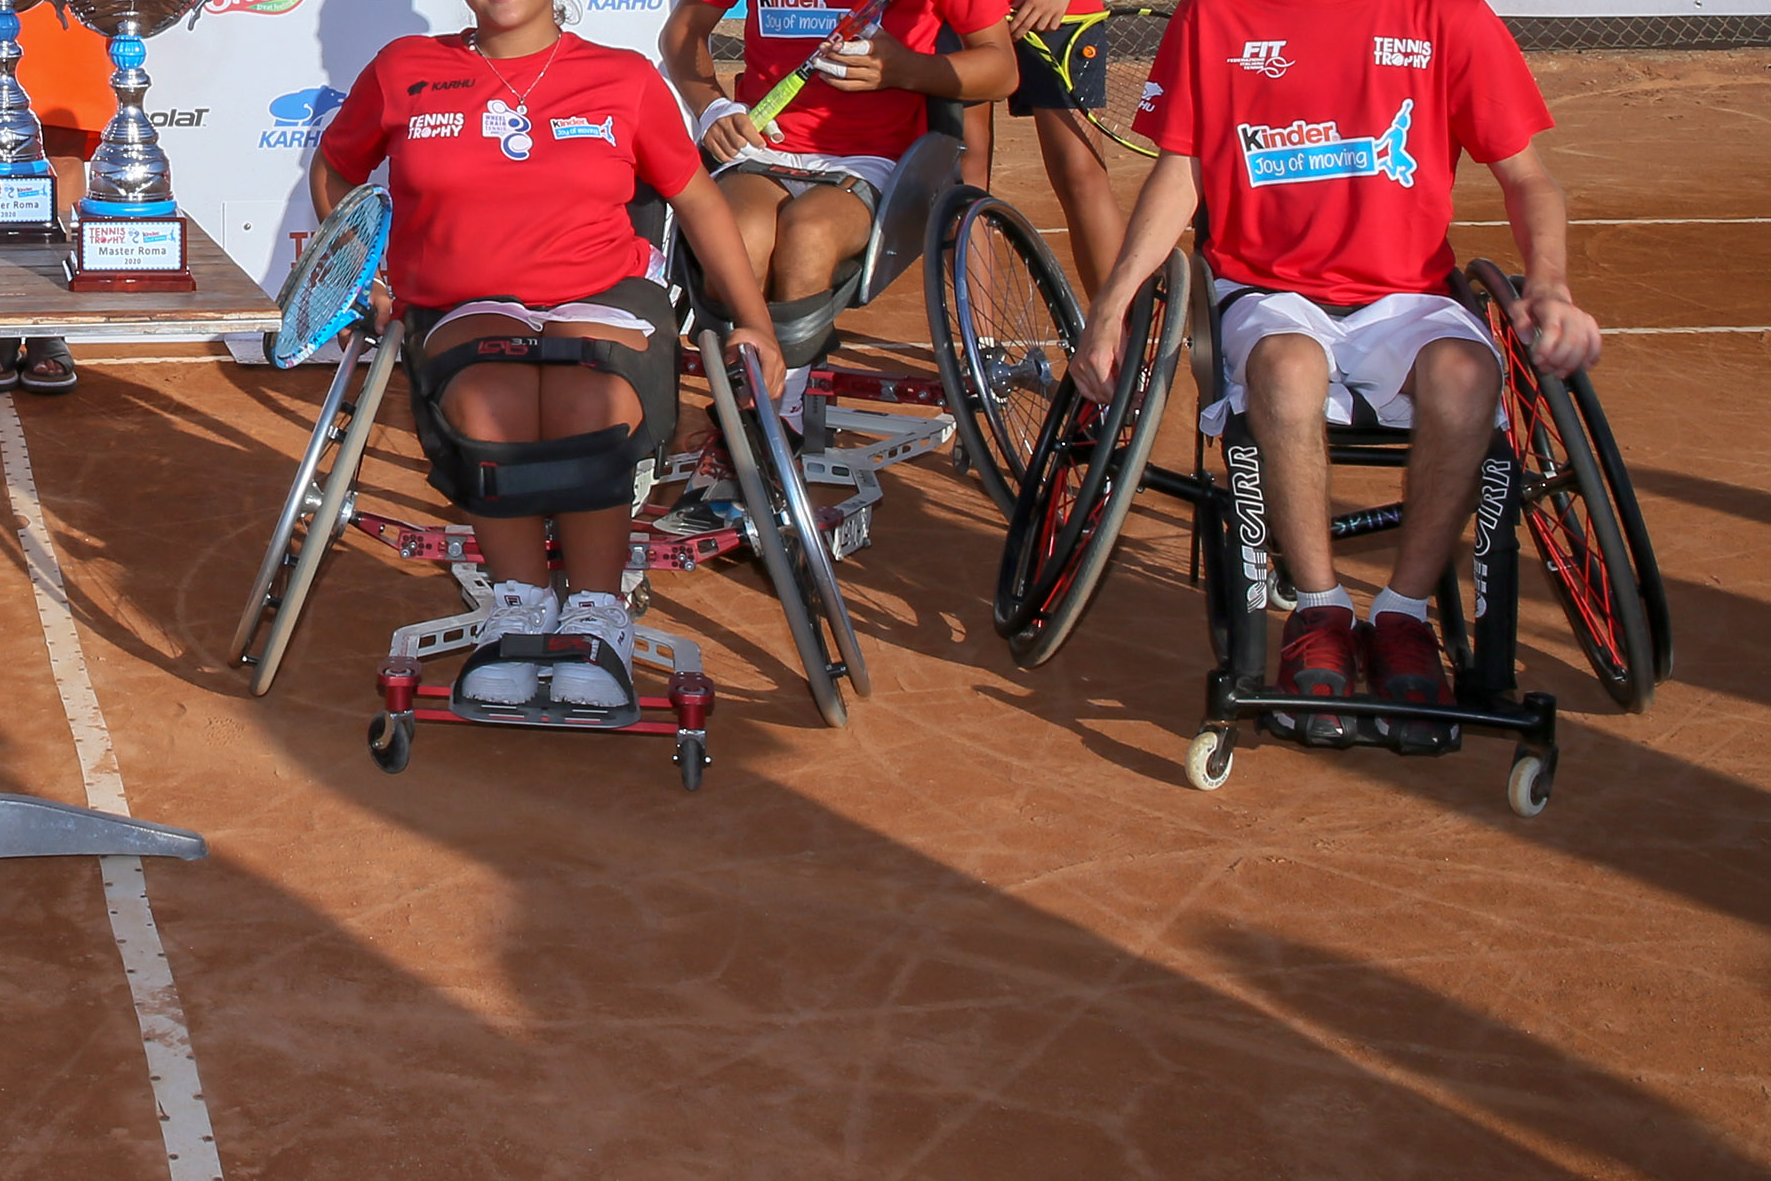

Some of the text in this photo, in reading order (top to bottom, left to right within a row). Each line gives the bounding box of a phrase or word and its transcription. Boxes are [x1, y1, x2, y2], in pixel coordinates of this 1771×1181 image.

[783, 14, 795, 29] of
[799, 15, 837, 29] movin
[1242, 40, 1287, 58] FIT
[1373, 36, 1432, 55] TENNIS
[1374, 51, 1431, 68] TROPHY
[431, 79, 476, 91] KARHU
[409, 113, 464, 127] TENNIS
[258, 130, 321, 149] KARH
[408, 125, 463, 139] TROPHY
[1241, 125, 1333, 152] Kinder
[1254, 148, 1368, 175] Joy of moving
[13, 201, 39, 209] Roma
[89, 227, 125, 236] TENNIS
[99, 246, 166, 255] Master Roma
